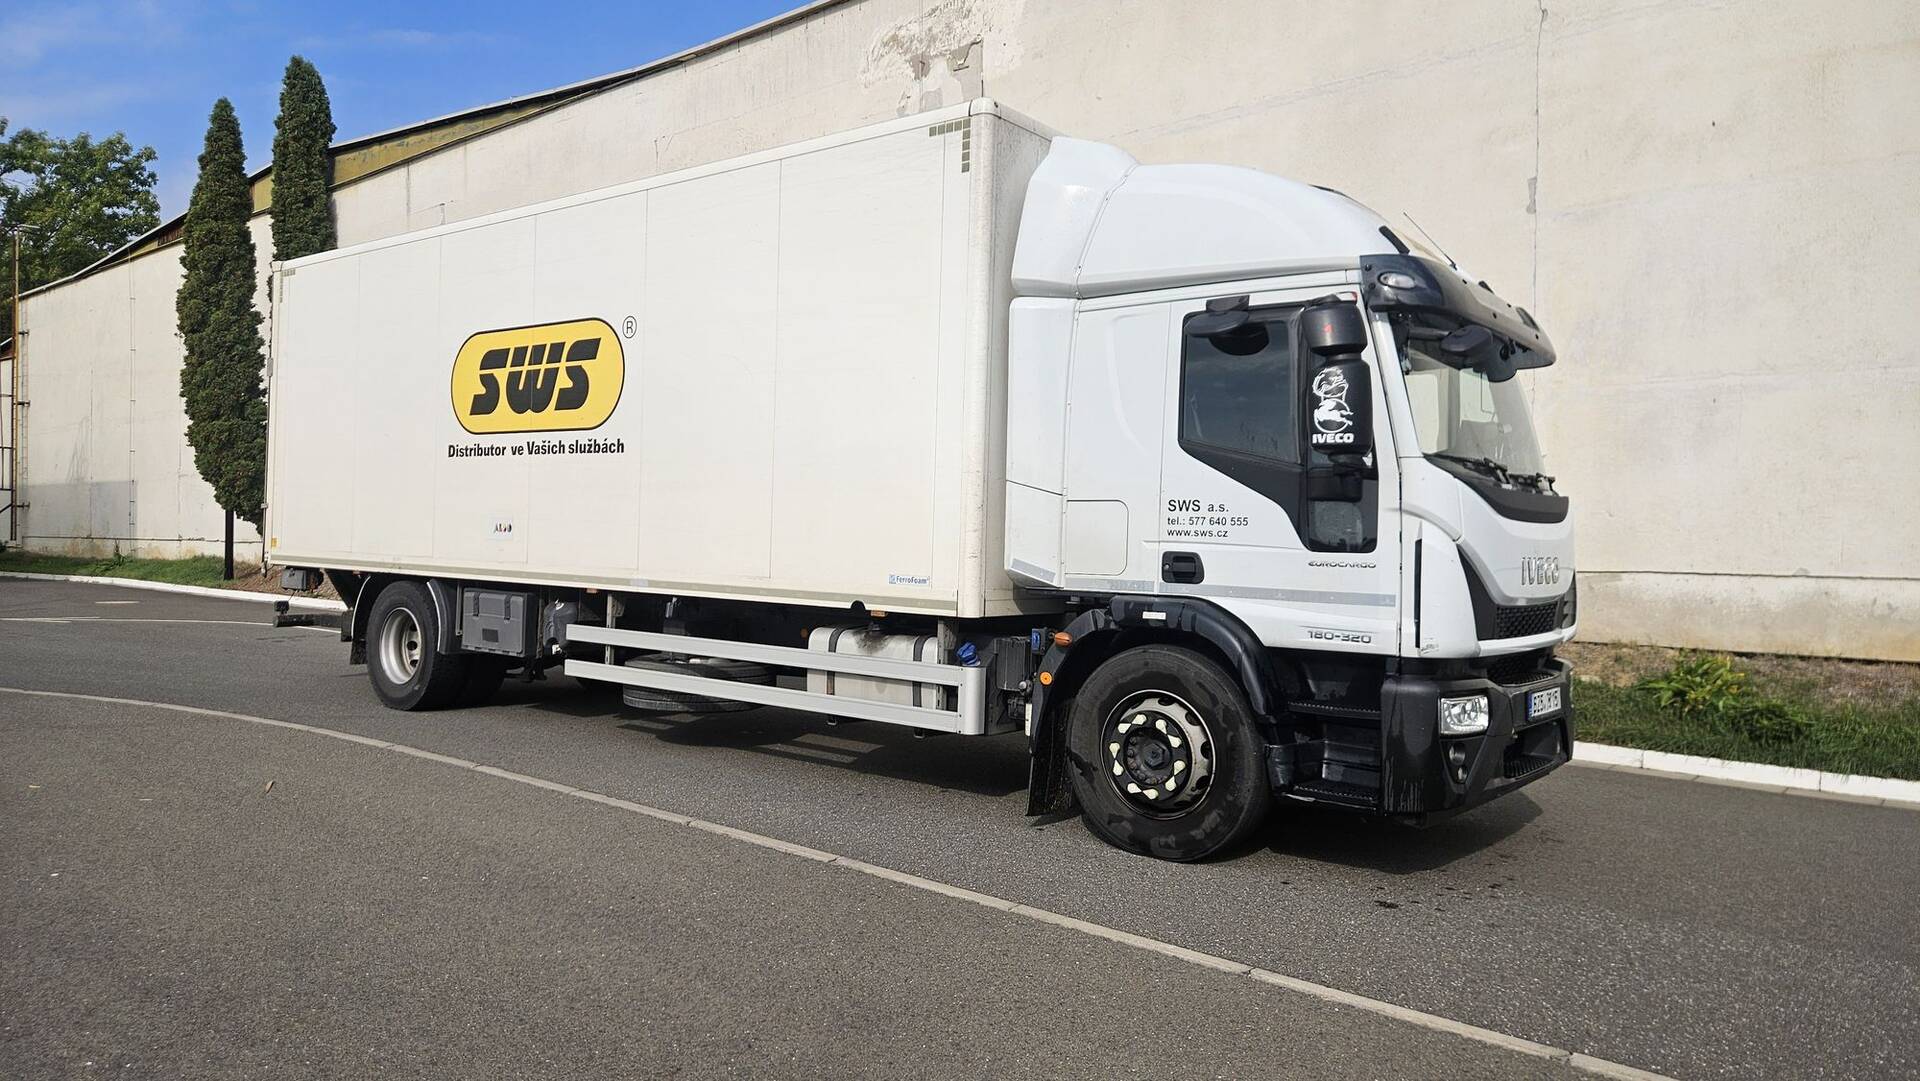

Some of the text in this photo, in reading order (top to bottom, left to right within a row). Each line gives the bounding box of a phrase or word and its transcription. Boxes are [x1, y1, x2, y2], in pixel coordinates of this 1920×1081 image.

[469, 337, 602, 416] SWS
[1312, 433, 1354, 444] IVECO
[448, 438, 625, 458] Distributor ve Vašich službách
[1167, 499, 1229, 512] SWS a.s.
[1167, 516, 1249, 526] tel.: 577 640 555
[1167, 529, 1229, 538] www.sws.cz
[1521, 556, 1559, 586] IVECO
